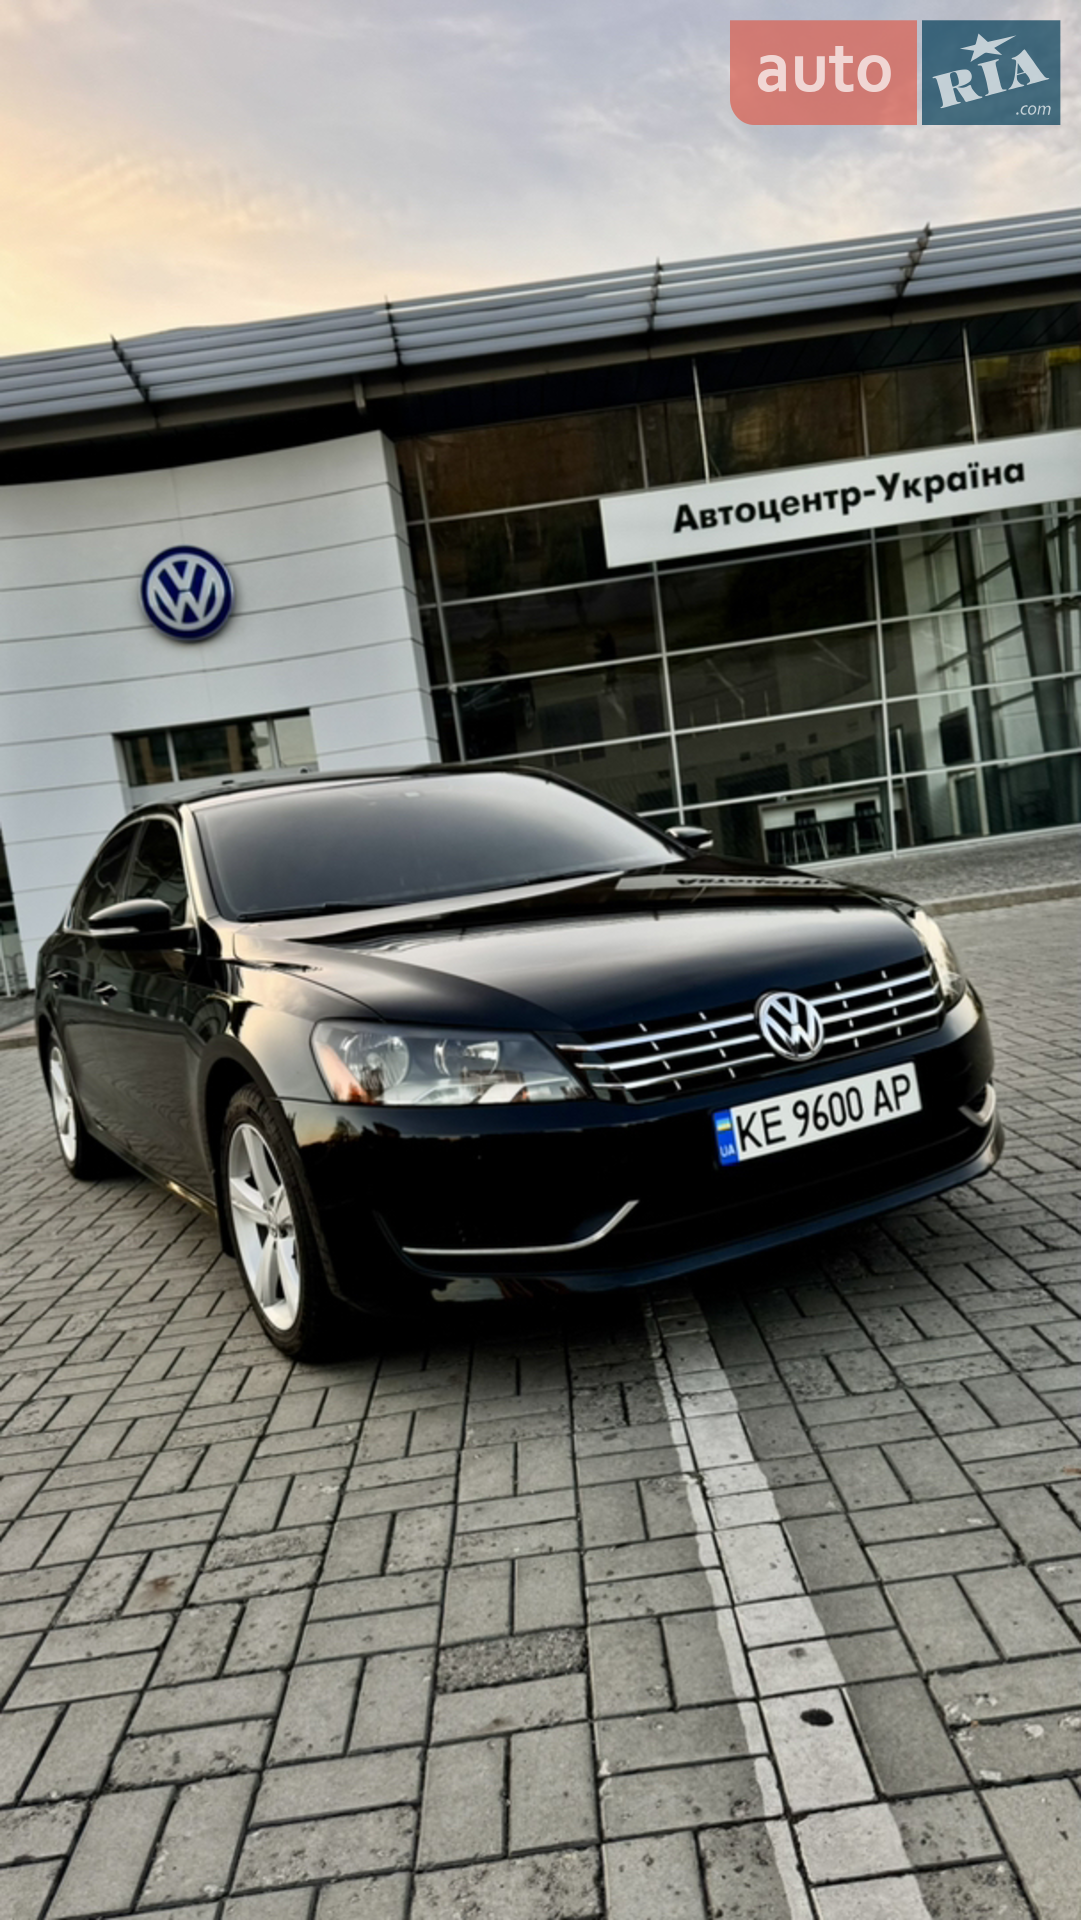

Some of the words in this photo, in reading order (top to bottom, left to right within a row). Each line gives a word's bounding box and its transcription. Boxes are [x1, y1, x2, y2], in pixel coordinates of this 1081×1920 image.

[673, 462, 1026, 534] Автоцентр-Україна
[736, 1105, 786, 1152] KE
[792, 1086, 865, 1138] 9600
[874, 1074, 912, 1117] AP
[720, 1143, 735, 1157] UA
